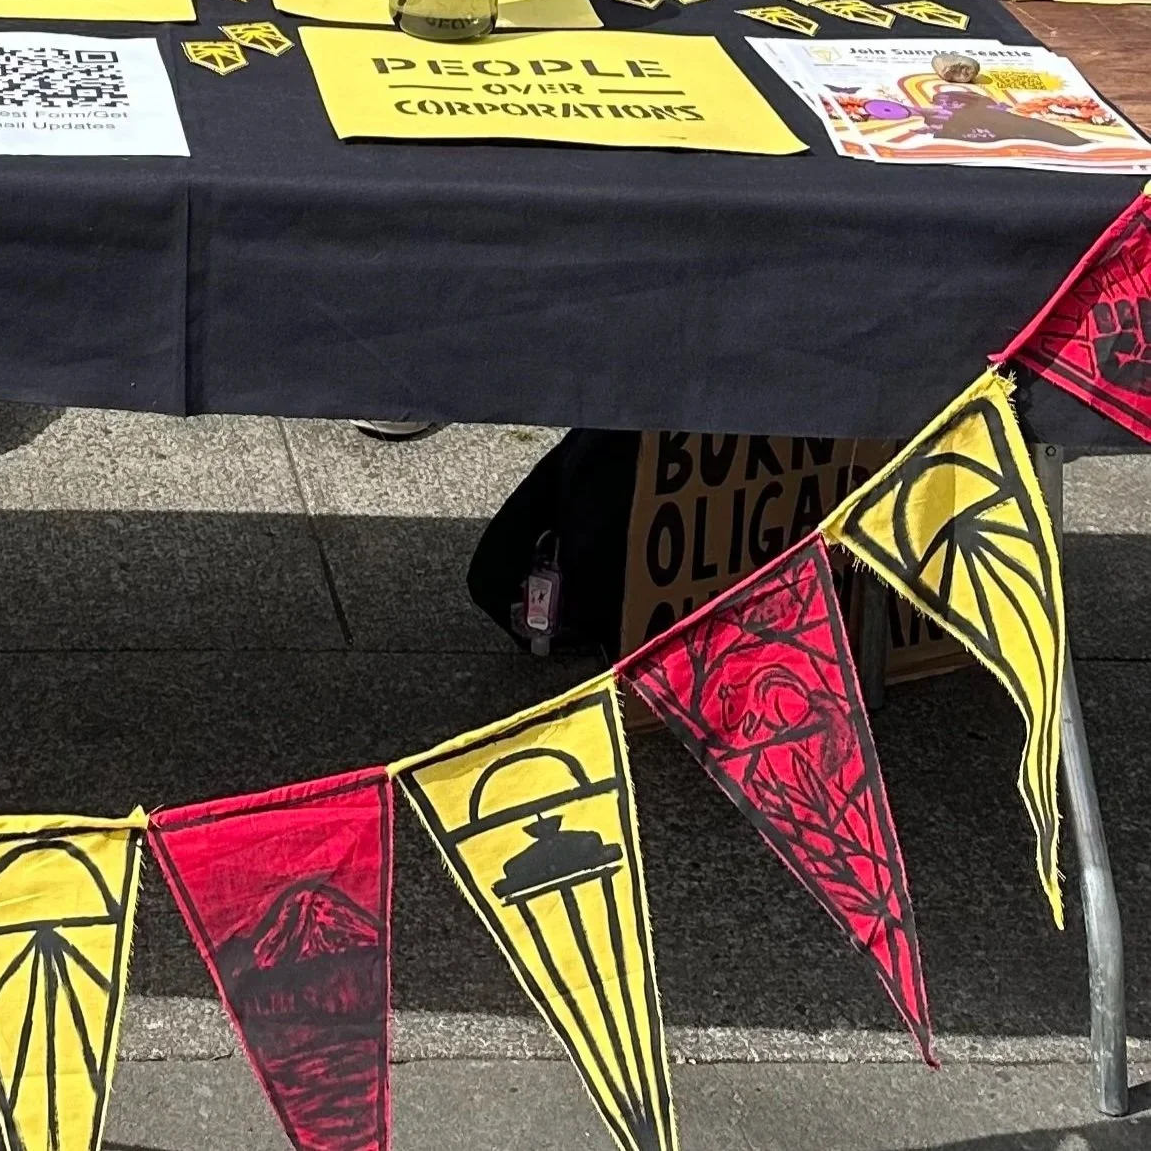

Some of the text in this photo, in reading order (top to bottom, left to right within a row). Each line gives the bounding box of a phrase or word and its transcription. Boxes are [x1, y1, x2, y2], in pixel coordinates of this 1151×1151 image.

[848, 47, 887, 55] Join
[965, 49, 1033, 57] Seattle
[371, 57, 671, 79] PEOPLE
[482, 82, 585, 95] OVER
[35, 110, 130, 119] Form/Get
[394, 99, 706, 122] CORPORATIONS
[32, 121, 117, 131] Updates
[646, 465, 870, 588] OLIGA
